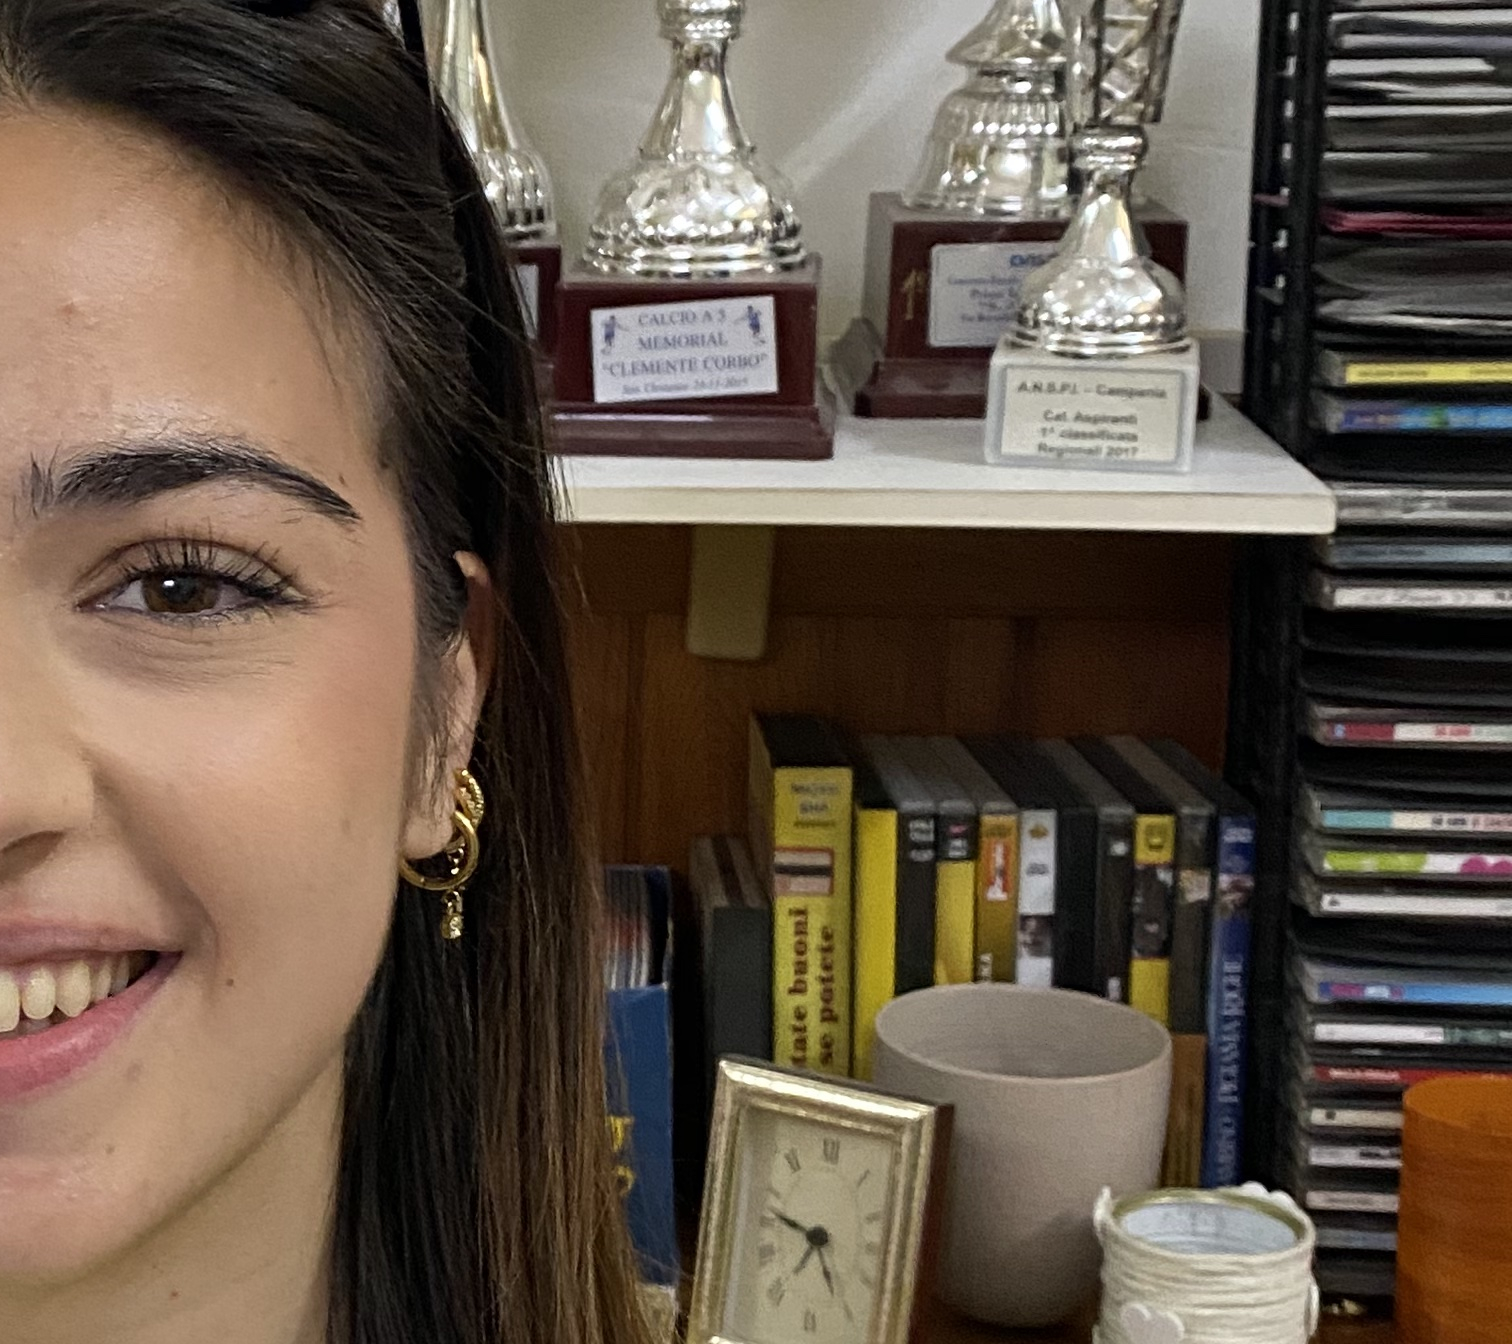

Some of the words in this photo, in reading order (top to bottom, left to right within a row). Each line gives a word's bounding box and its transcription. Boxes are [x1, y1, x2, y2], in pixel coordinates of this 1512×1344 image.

[638, 308, 697, 327] CALCIO
[702, 309, 714, 324] A
[638, 332, 729, 351] MEMORIAL
[788, 908, 808, 995] buoni
[791, 1006, 808, 1067] tate
